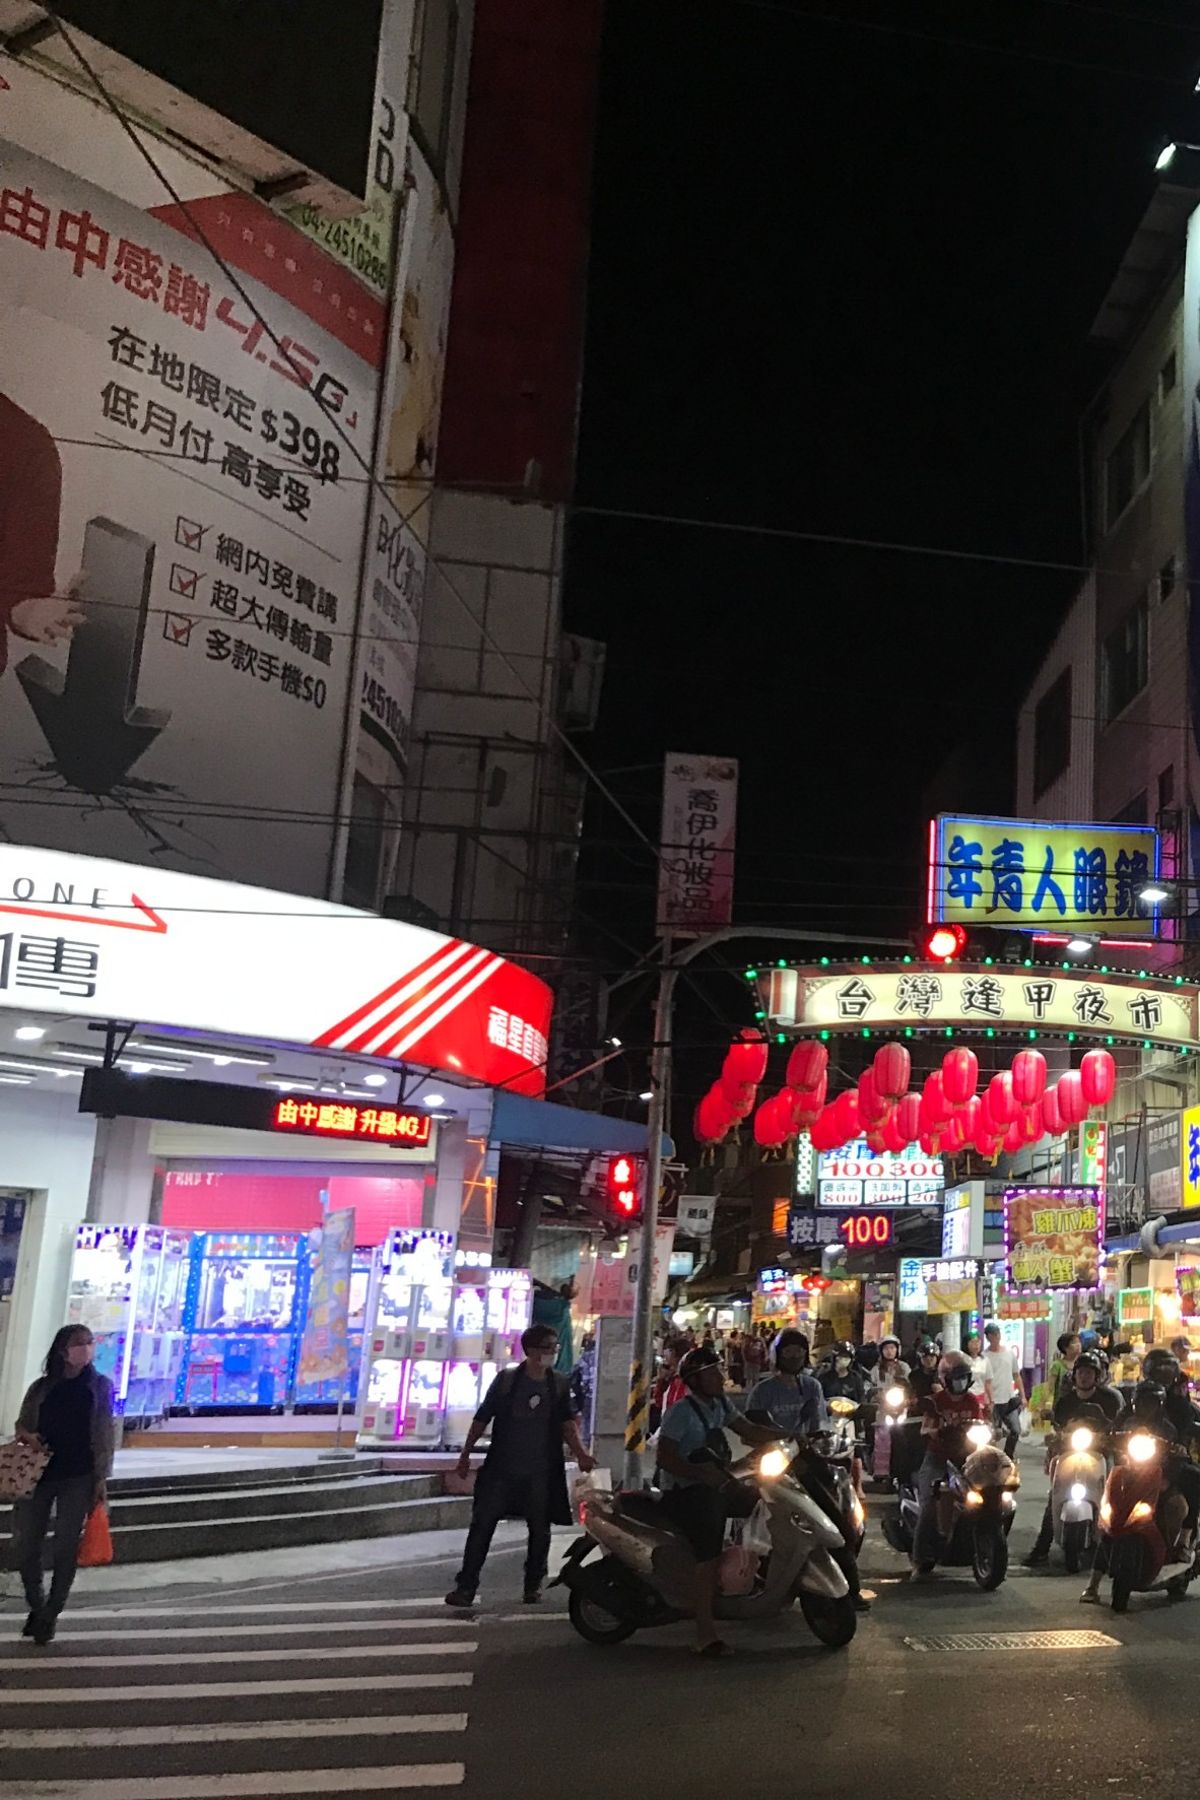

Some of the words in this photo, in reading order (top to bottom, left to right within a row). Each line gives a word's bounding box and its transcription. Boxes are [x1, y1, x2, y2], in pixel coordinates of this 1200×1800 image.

[210, 579, 334, 666] 超大傳輸量
[946, 835, 1150, 920] 年青人眼鏡
[836, 975, 1164, 1031] 台灣逢甲夜市
[823, 1162, 885, 1177] 100
[790, 1216, 839, 1244] 按摩
[841, 1216, 889, 1244] 100
